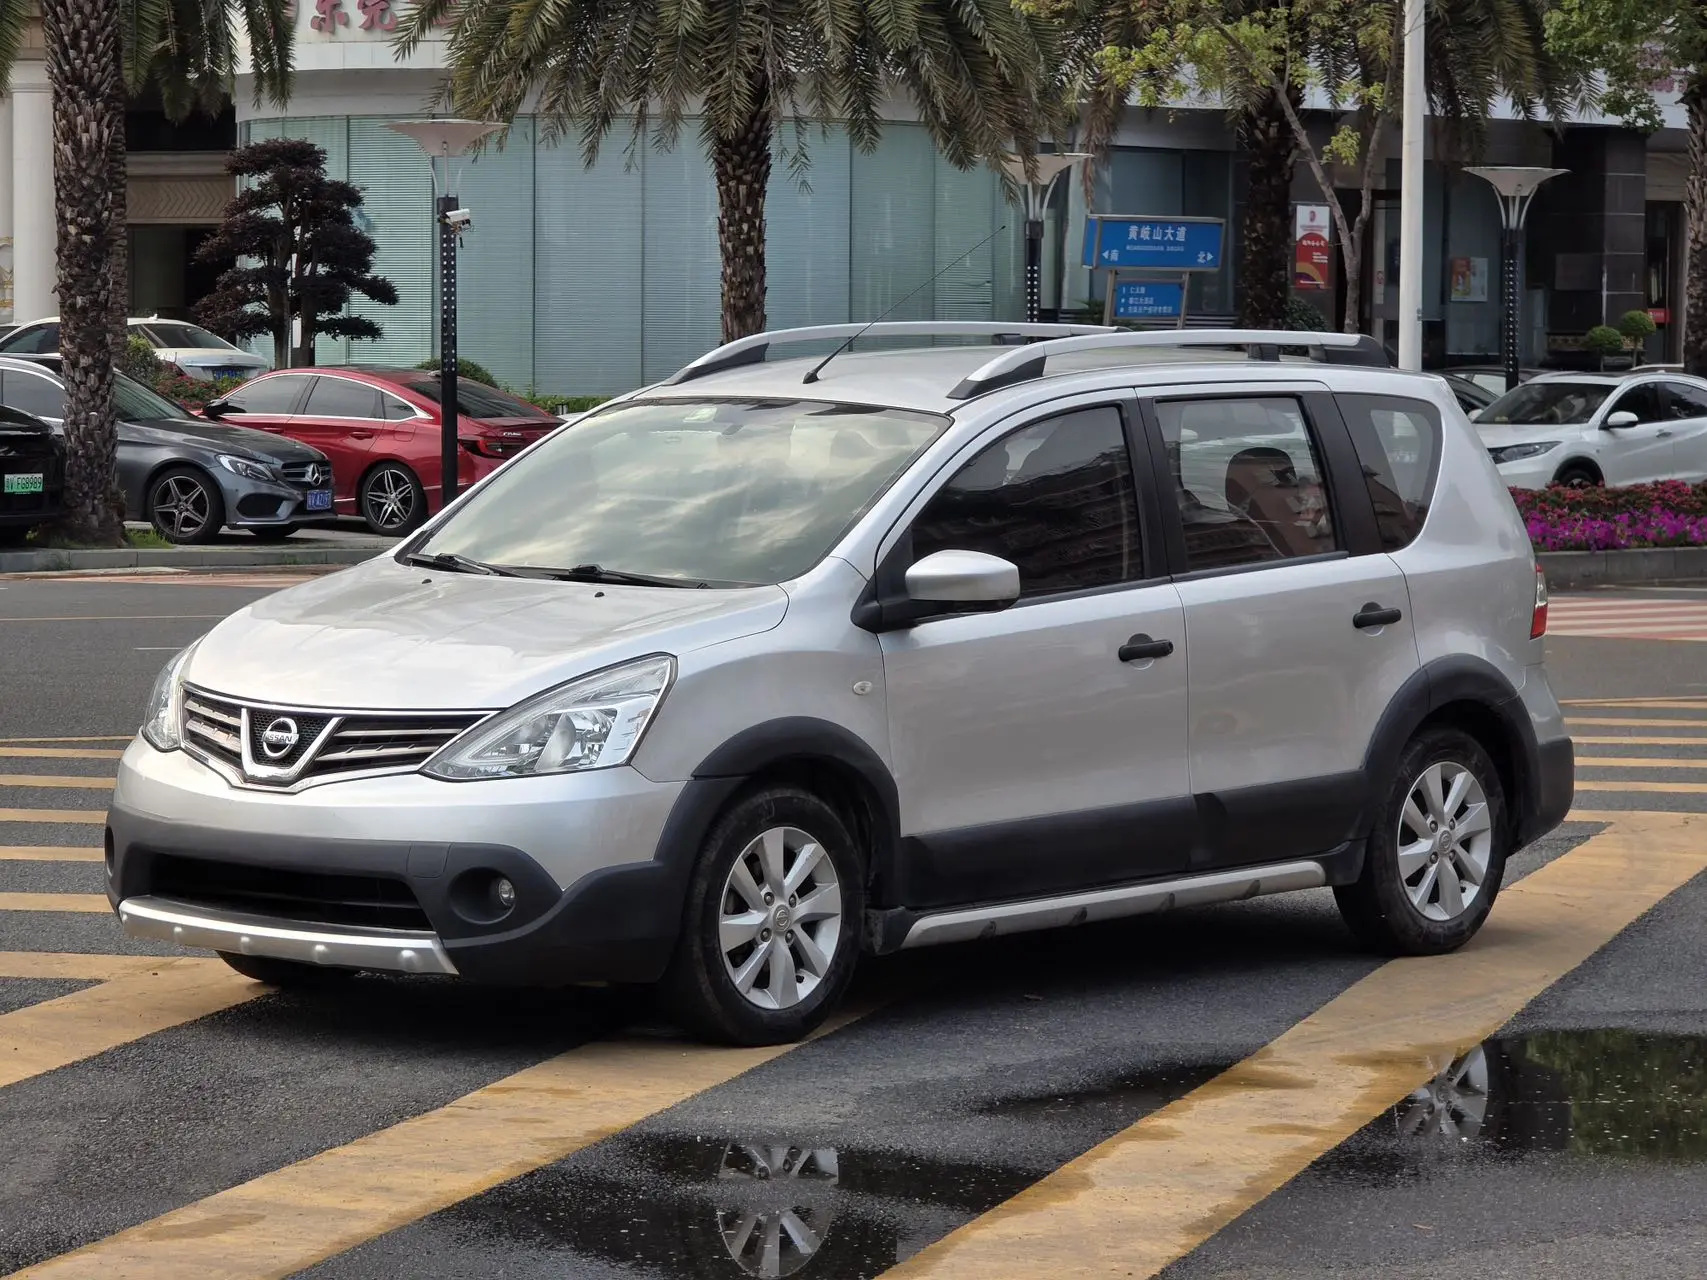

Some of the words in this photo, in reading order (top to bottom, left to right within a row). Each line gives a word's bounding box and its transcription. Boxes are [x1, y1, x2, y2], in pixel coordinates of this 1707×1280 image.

[1128, 225, 1187, 241] 黄岐山大道
[1110, 250, 1119, 261] 南
[1197, 251, 1206, 263] 北
